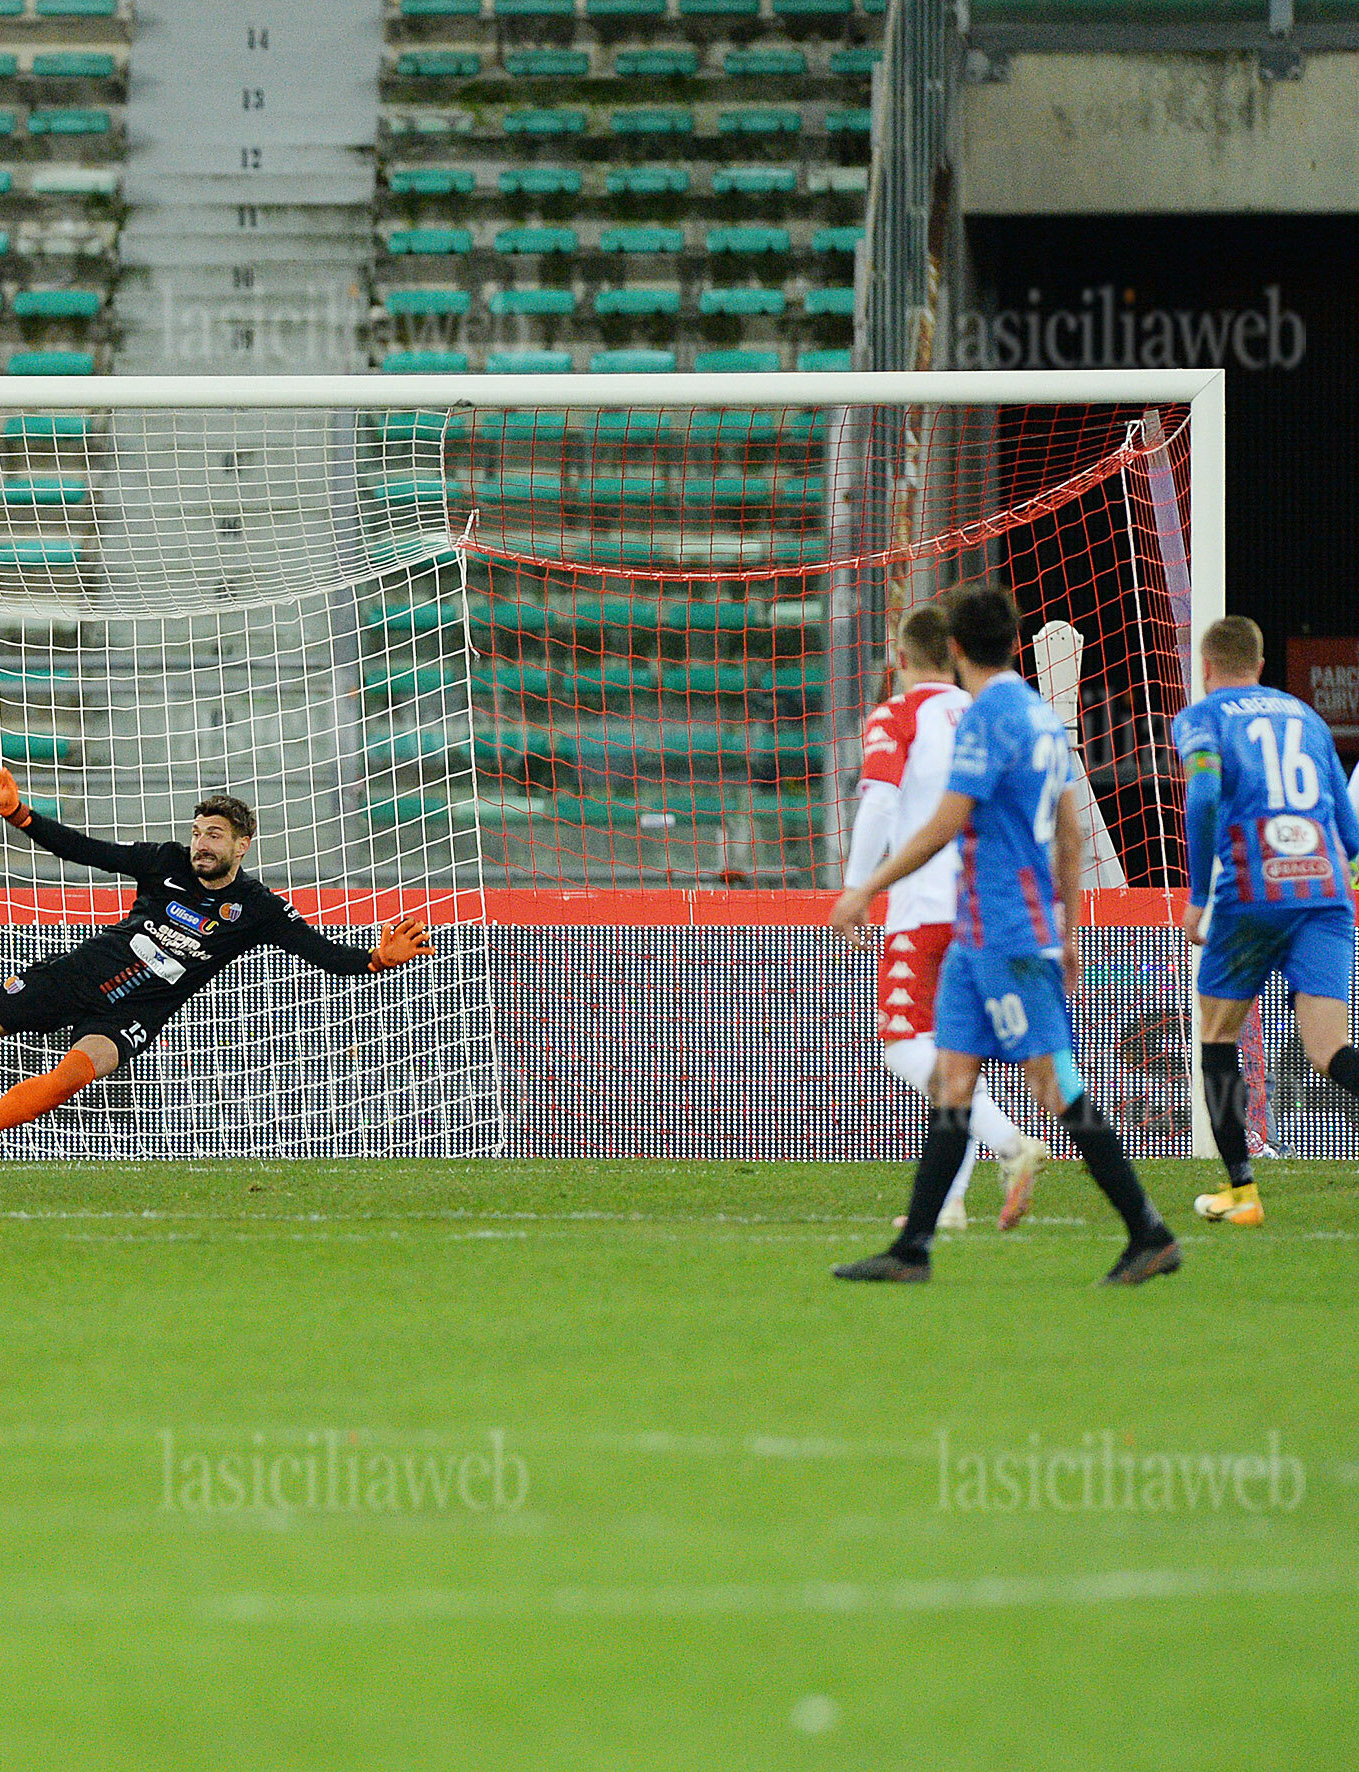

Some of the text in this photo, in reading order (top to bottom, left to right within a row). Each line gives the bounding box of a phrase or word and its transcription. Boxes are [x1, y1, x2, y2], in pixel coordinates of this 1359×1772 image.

[247, 28, 269, 50] 14
[242, 87, 264, 110] 13
[240, 147, 261, 169] 12
[1246, 716, 1321, 810] 16
[170, 904, 200, 924] Ulisse
